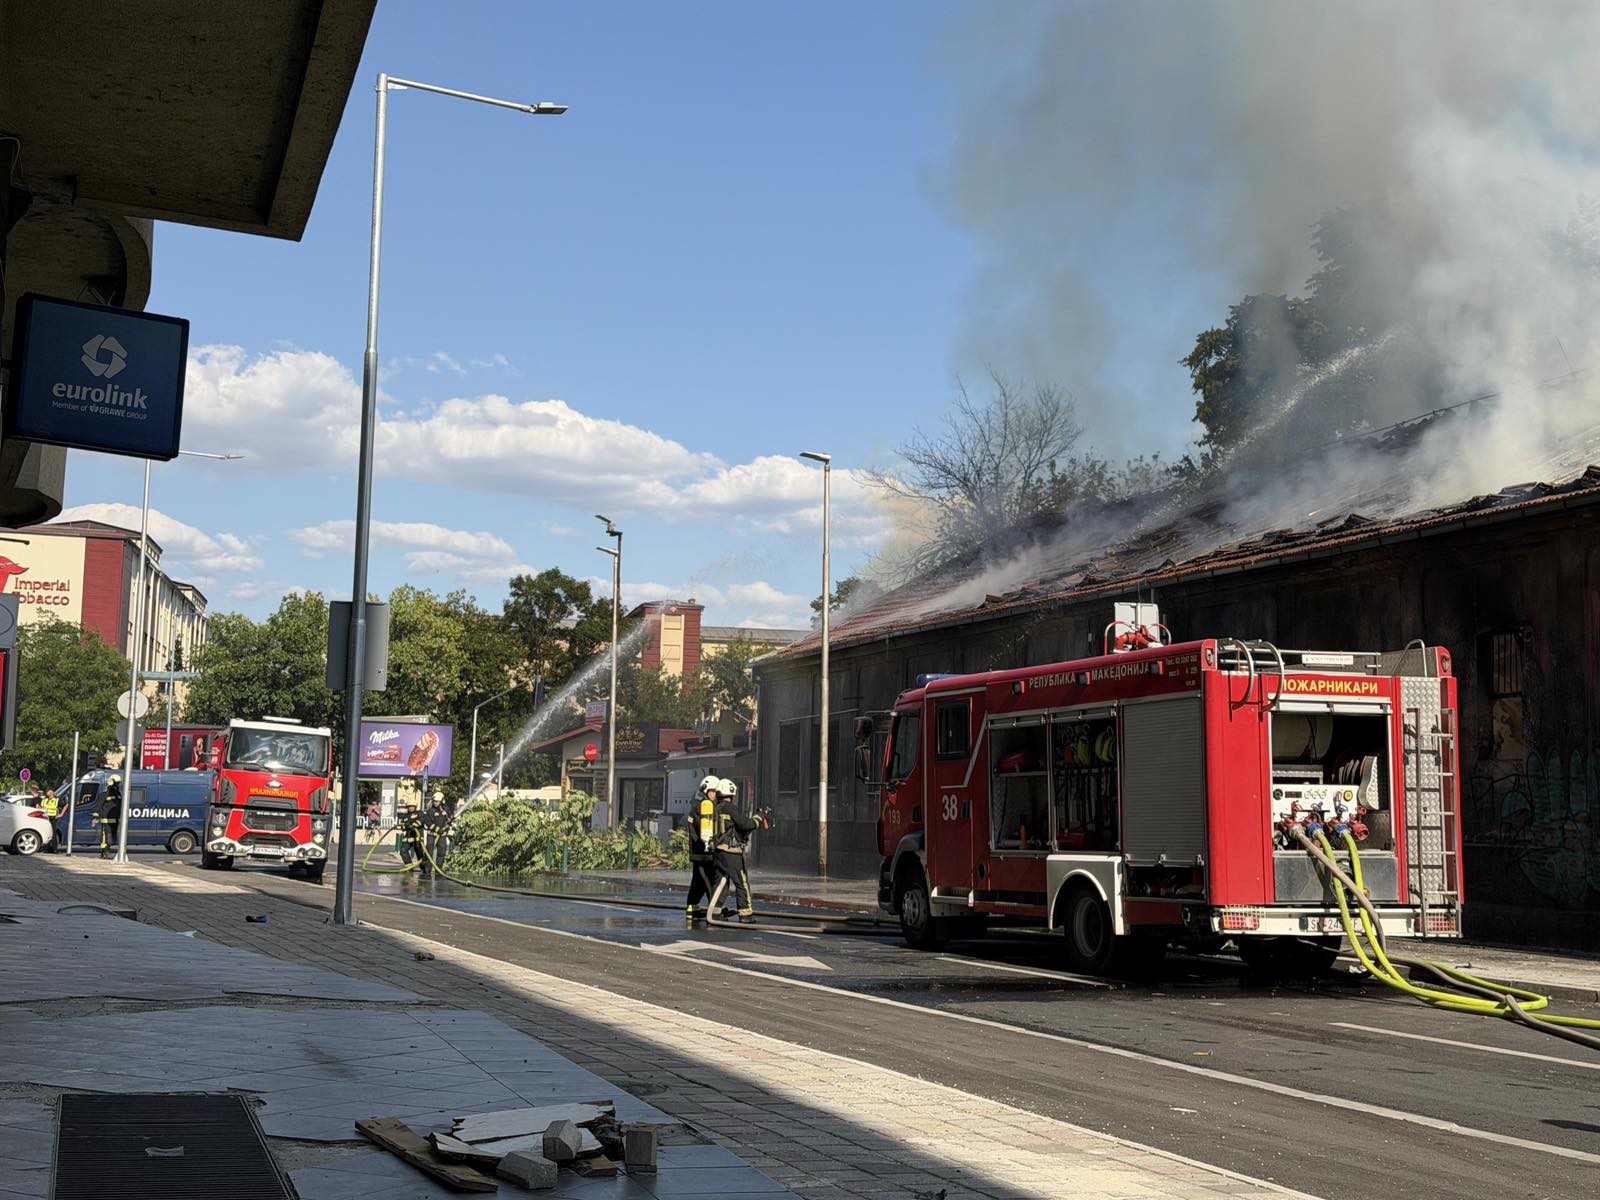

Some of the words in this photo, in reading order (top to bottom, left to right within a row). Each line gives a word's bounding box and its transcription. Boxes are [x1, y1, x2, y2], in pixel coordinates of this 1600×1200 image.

[52, 382, 149, 410] eurolink
[52, 400, 80, 411] Member
[80, 404, 89, 412] of
[99, 406, 127, 418] GRAWE
[126, 411, 148, 420] GROUP
[14, 577, 70, 593] Imperial
[1029, 673, 1076, 689] РЕПУБЛИКА
[1091, 662, 1149, 681] МАКЕДОНИЈА
[369, 729, 400, 744] Milka
[888, 809, 901, 825] 193
[942, 794, 958, 821] 38
